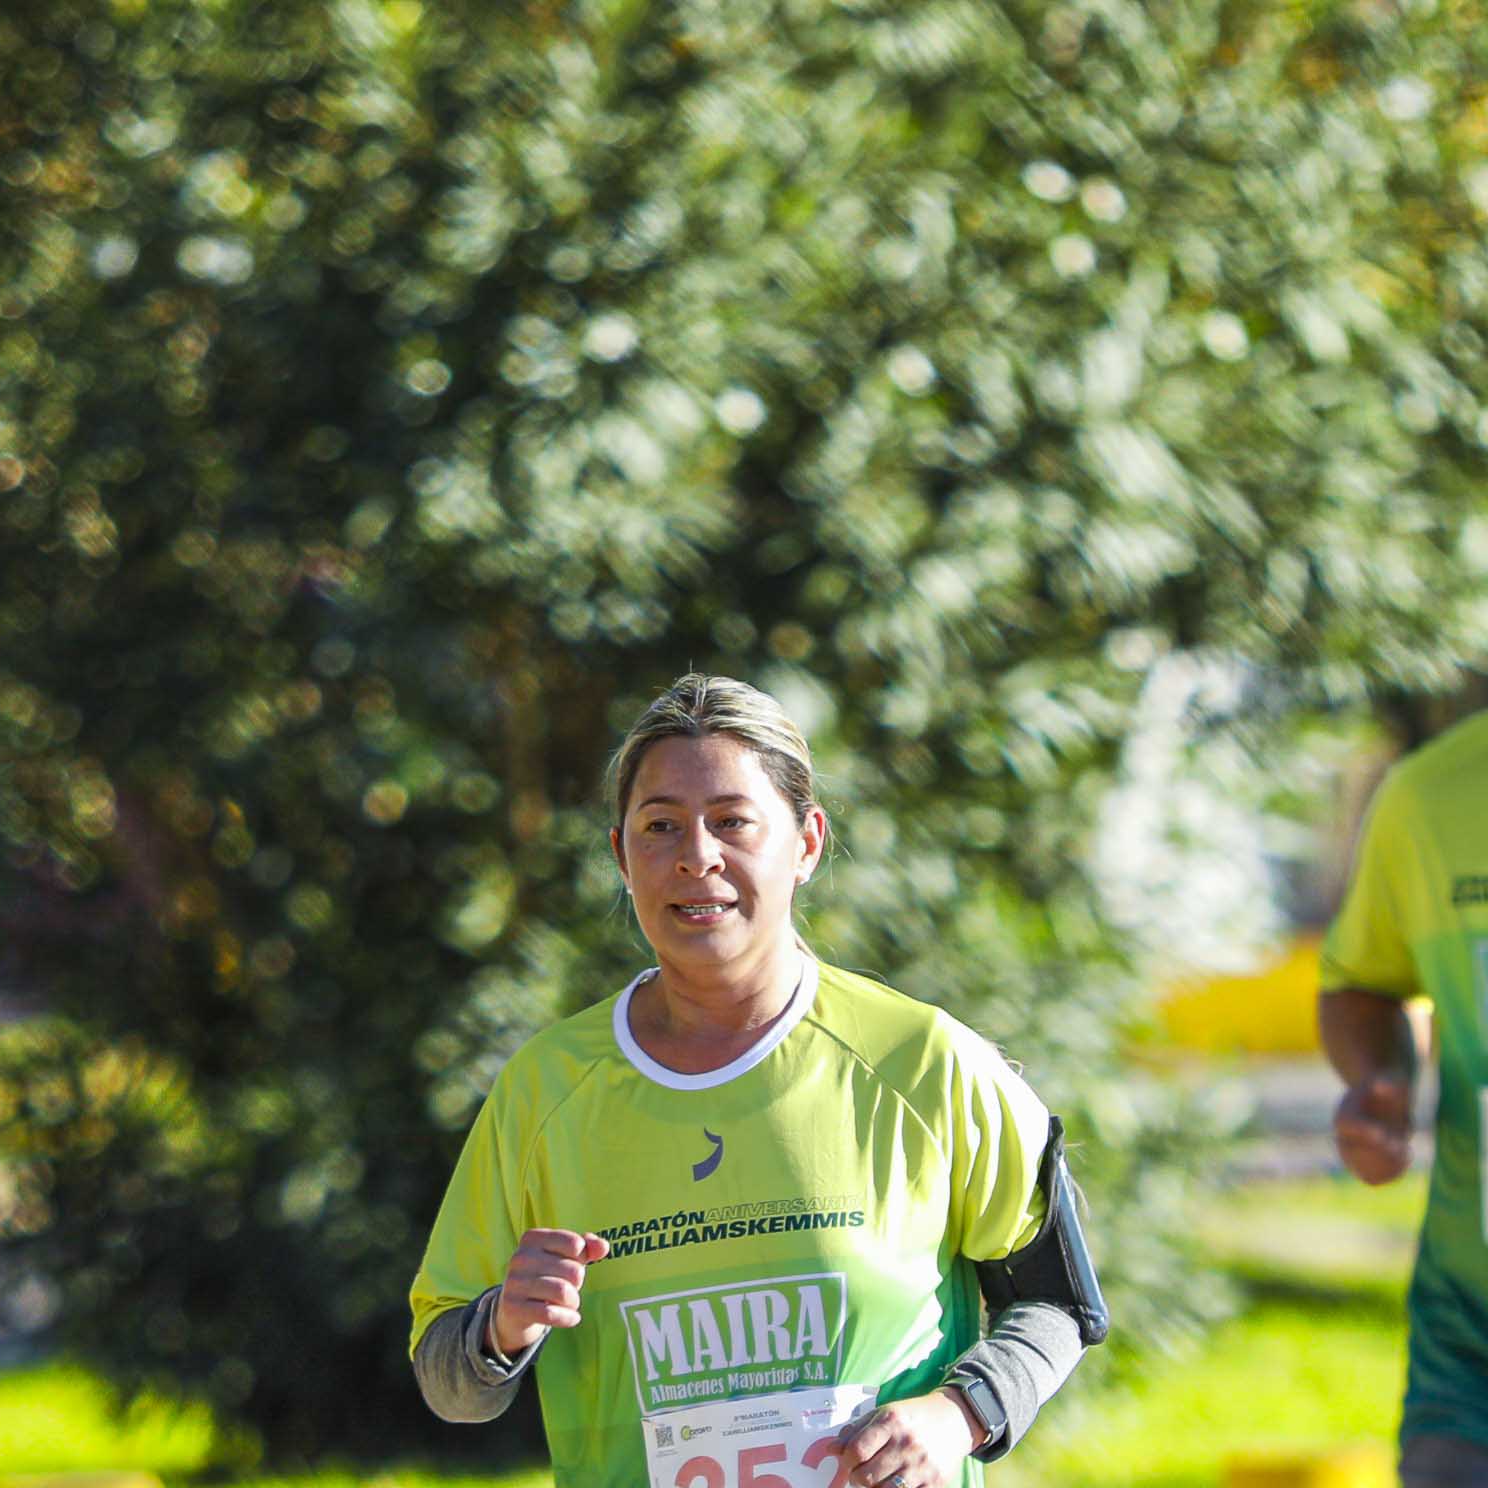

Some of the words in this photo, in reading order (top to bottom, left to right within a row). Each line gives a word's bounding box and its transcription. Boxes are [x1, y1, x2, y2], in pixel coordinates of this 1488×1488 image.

[588, 1211, 864, 1265] WILLIAMSKEMMIS
[596, 1210, 705, 1242] MARATÓN
[634, 1285, 830, 1381] MAIRA
[650, 1376, 725, 1405] Almacenes
[803, 1361, 829, 1380] S.A.
